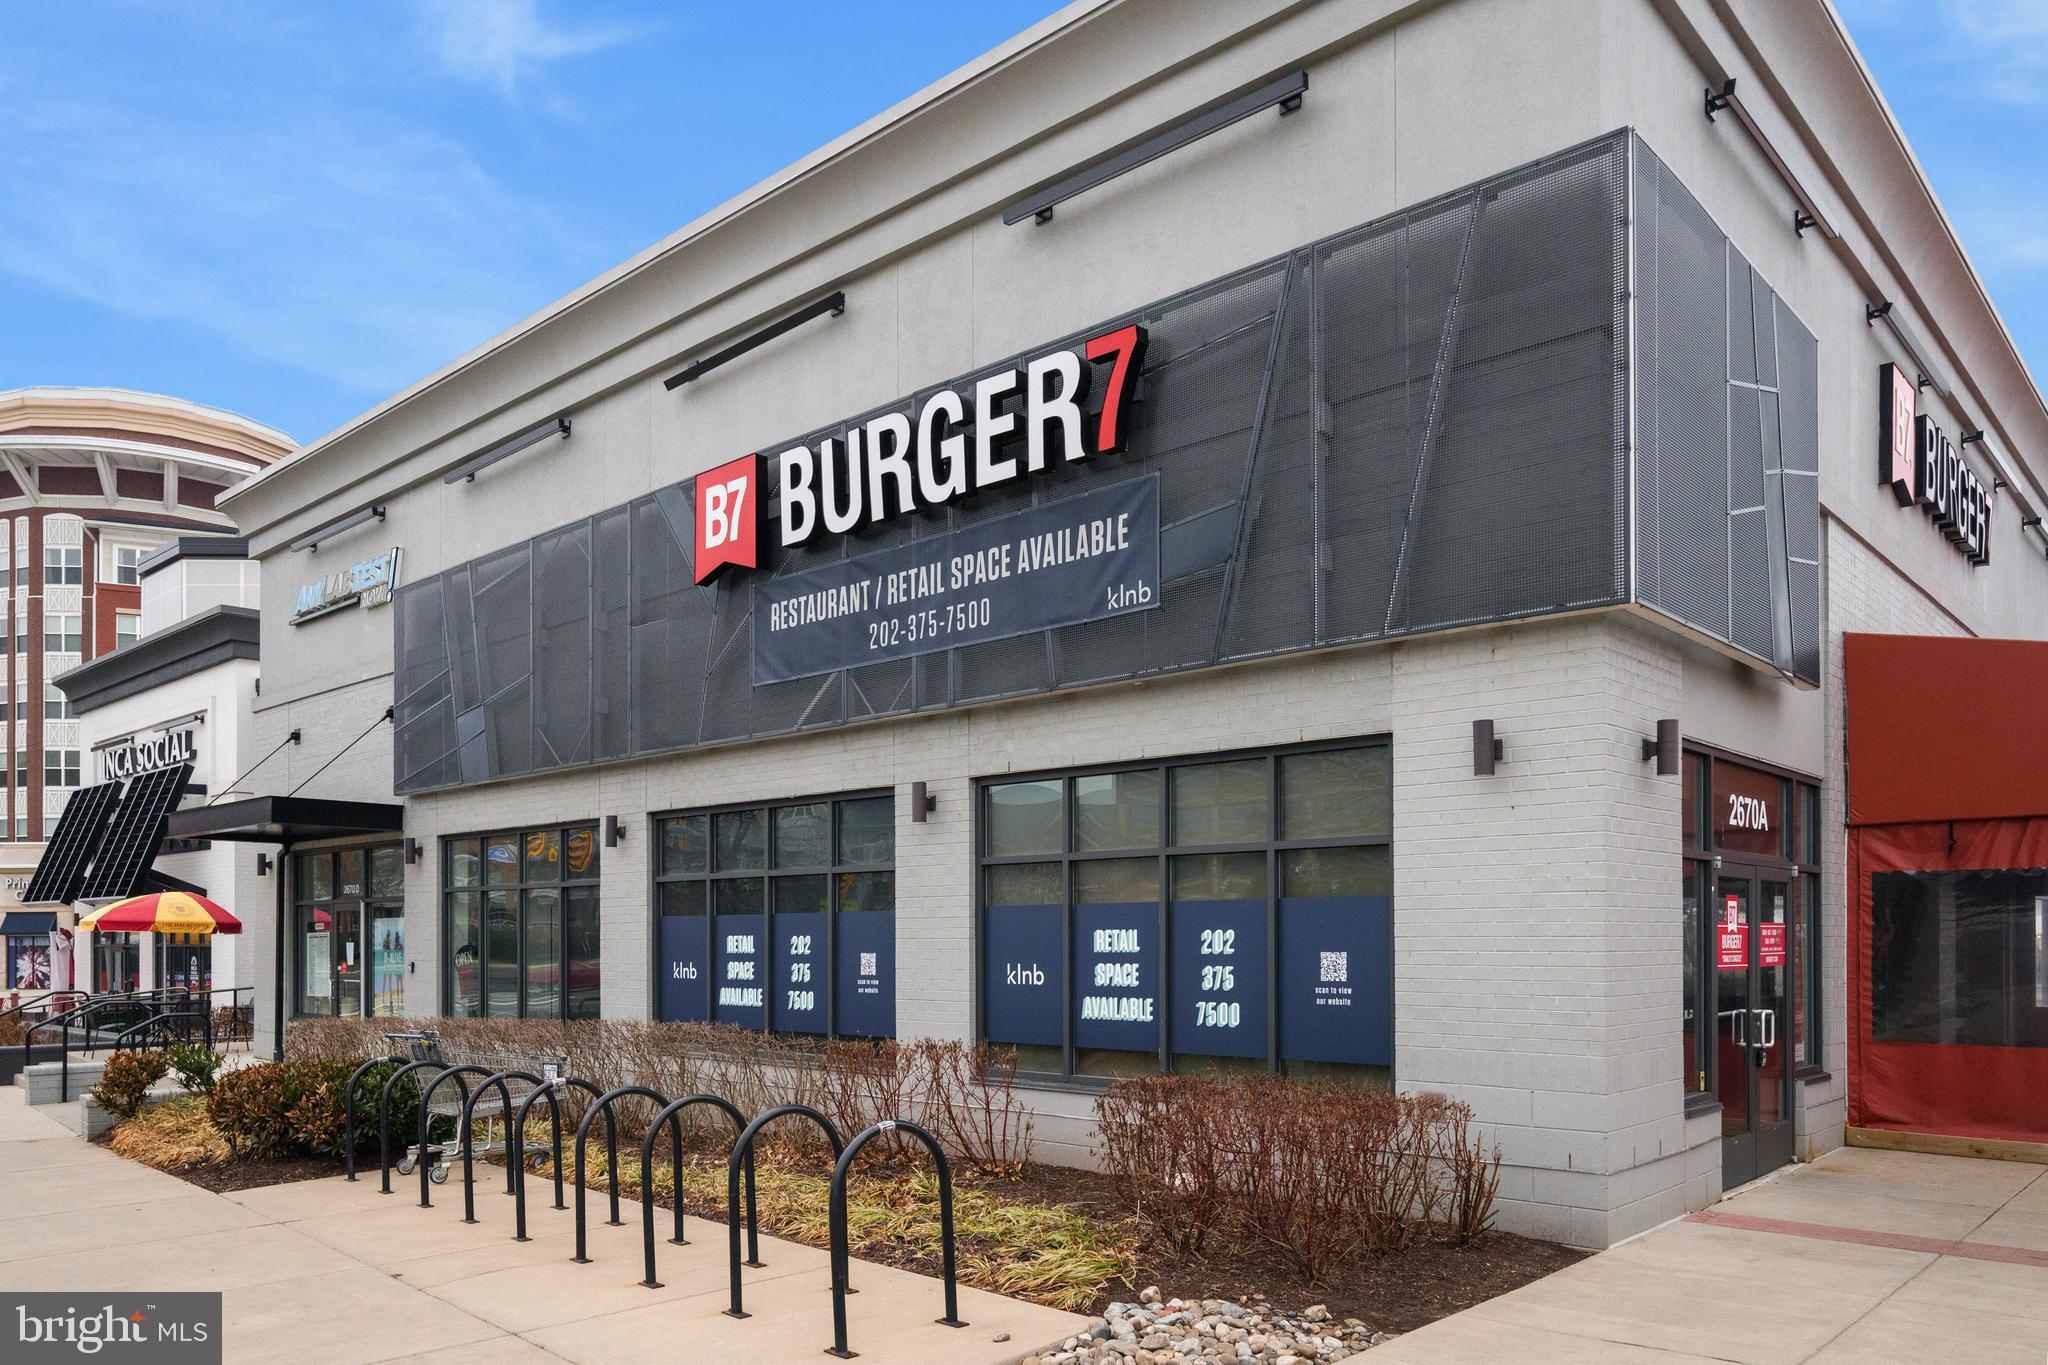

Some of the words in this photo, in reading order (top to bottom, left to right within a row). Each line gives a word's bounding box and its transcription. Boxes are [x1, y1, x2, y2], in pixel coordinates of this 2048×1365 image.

[705, 476, 748, 550] B7
[770, 580, 870, 632] RESTAURANT
[887, 562, 945, 606] RETAIL
[951, 543, 1011, 590] SPACE
[1017, 513, 1129, 575] AVAILABLE
[1107, 580, 1152, 611] klnb
[869, 597, 990, 650] 202-375-7500
[102, 748, 133, 779] INCA
[136, 730, 191, 772] SOCIAL
[1729, 793, 1769, 831] 2670A
[726, 935, 755, 954] RETAIL
[790, 935, 811, 955] 202
[1093, 929, 1140, 954] RETAIL
[1200, 929, 1235, 956] 202
[673, 961, 698, 980] klnb
[727, 961, 755, 981] SPACE
[790, 963, 811, 983] 375
[1007, 963, 1045, 986] klnb
[1094, 962, 1140, 988] SPACE
[1201, 965, 1235, 991] 375
[719, 987, 763, 1008] AVAILABLE
[787, 990, 814, 1011] 7500
[1327, 997, 1351, 1006] website
[1330, 986, 1337, 994] to
[1338, 986, 1352, 994] view
[1081, 996, 1154, 1022] AVAILABLE
[1195, 1001, 1240, 1028] 7500
